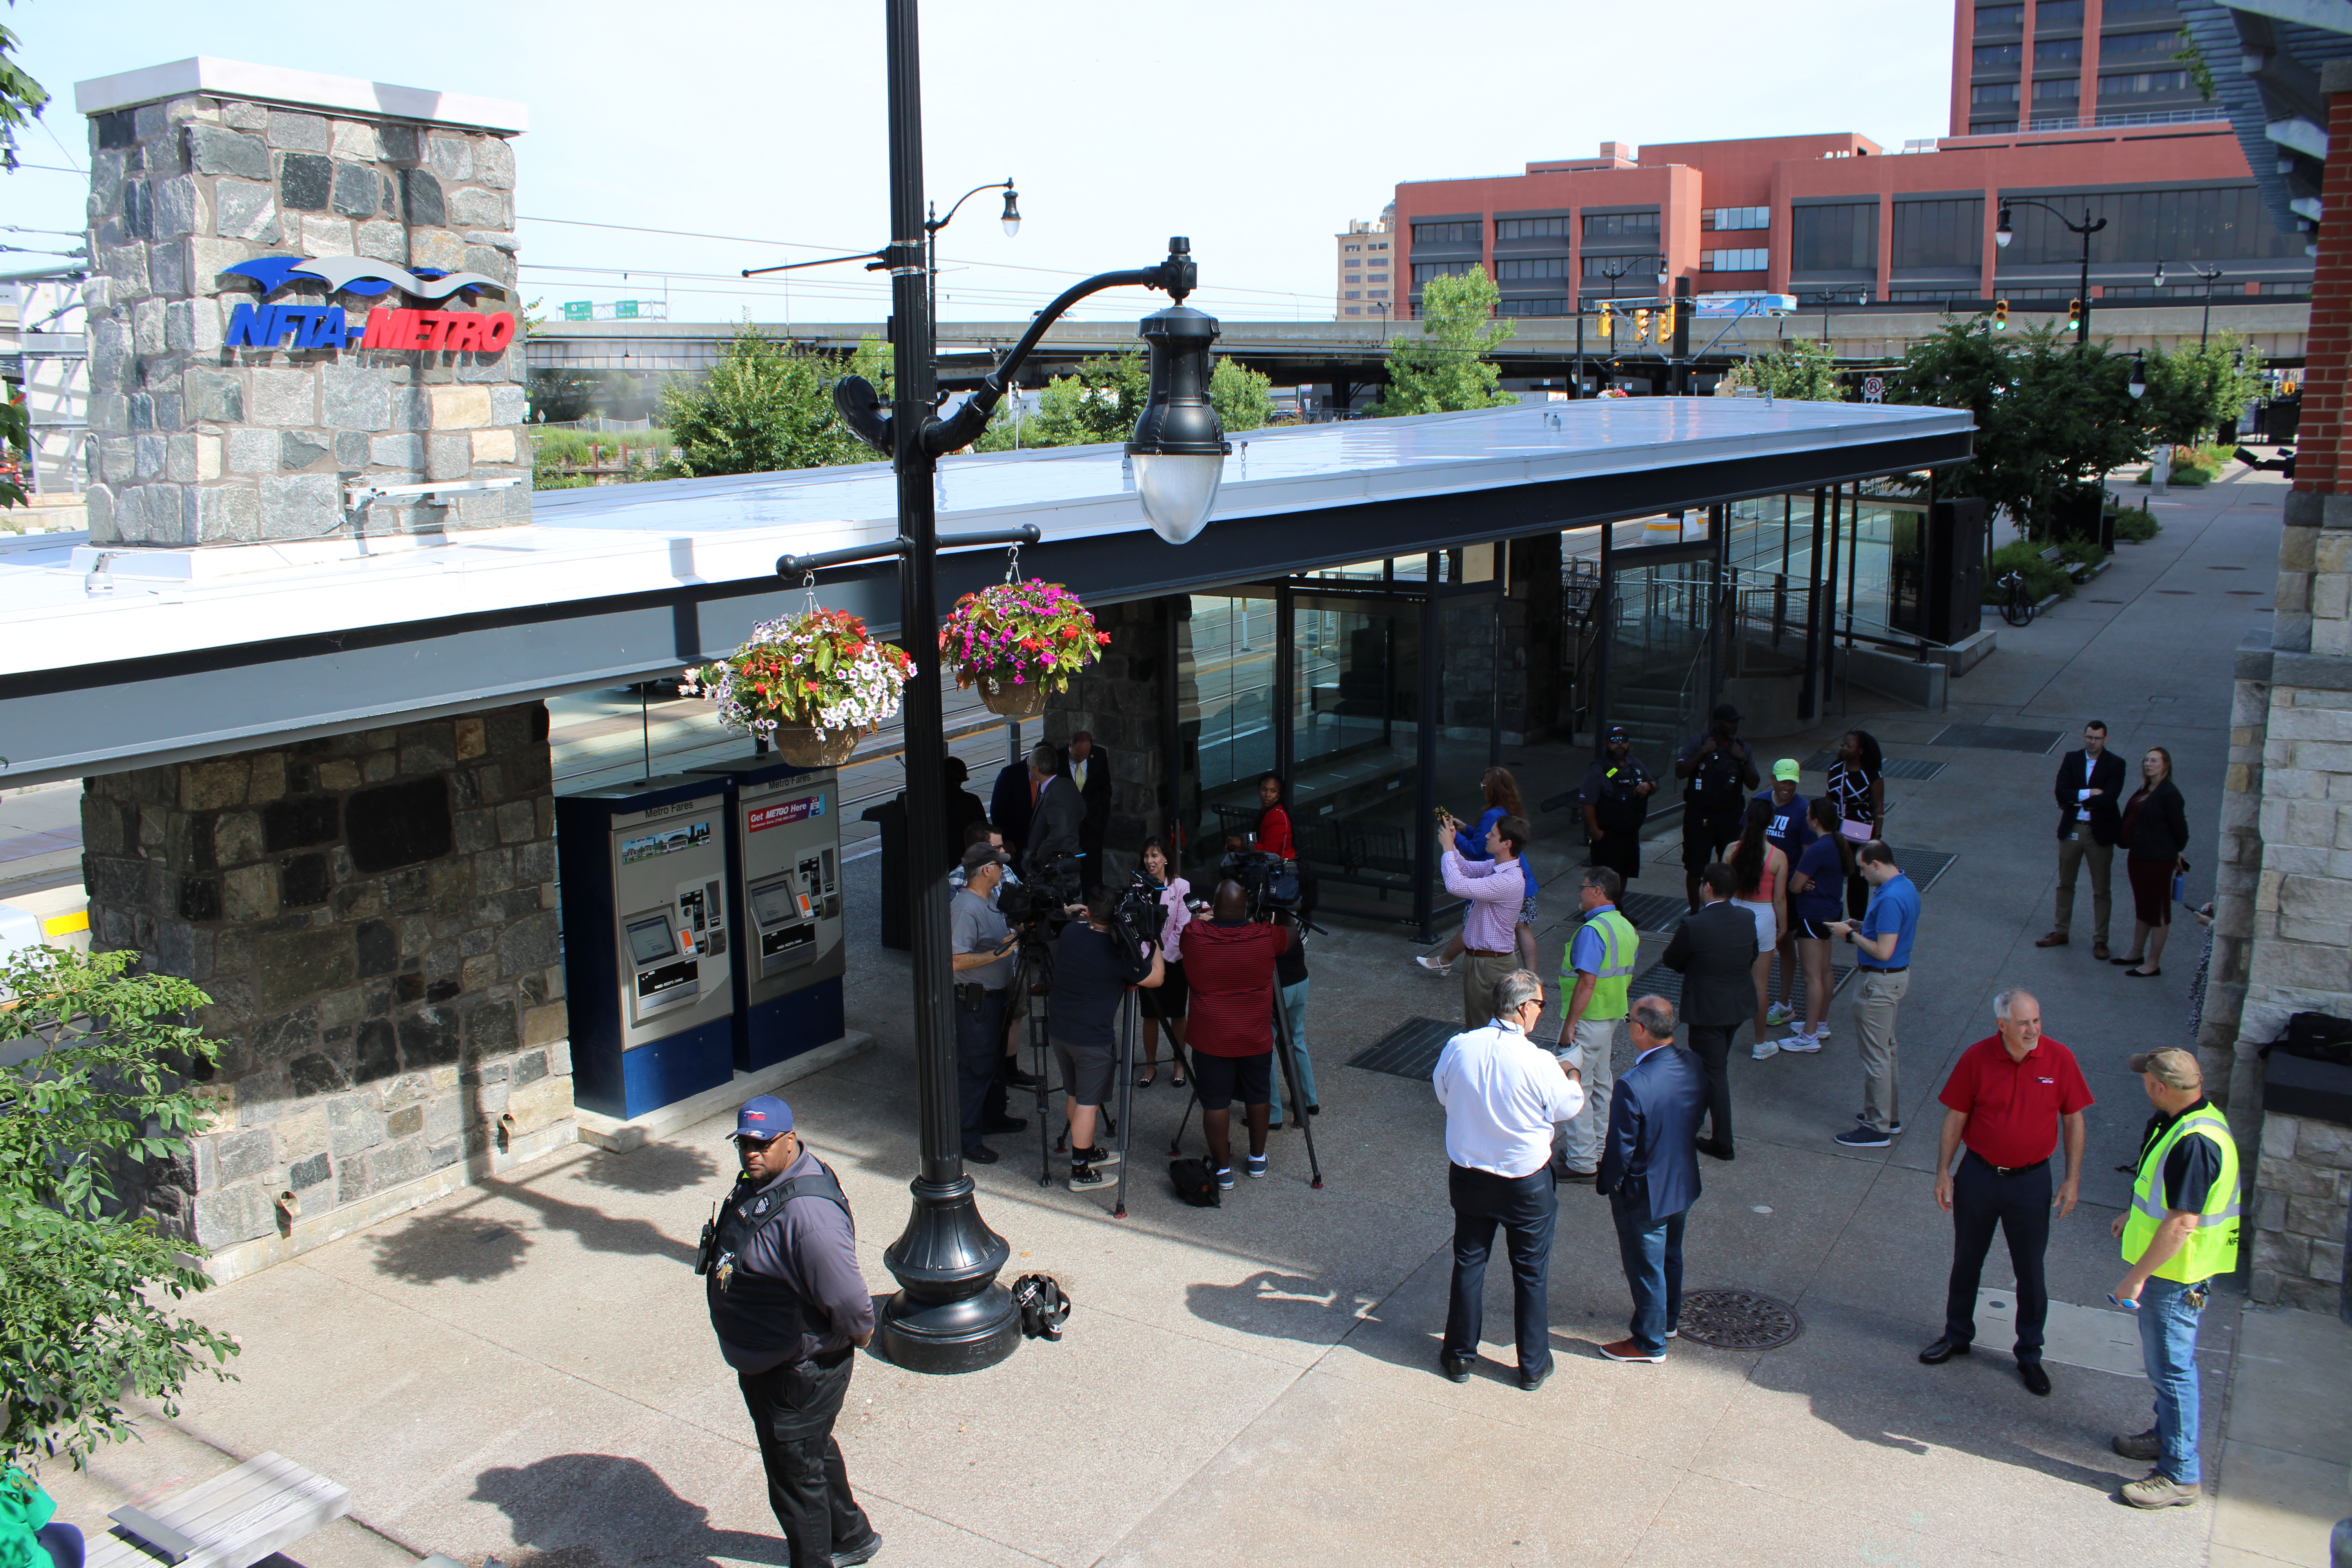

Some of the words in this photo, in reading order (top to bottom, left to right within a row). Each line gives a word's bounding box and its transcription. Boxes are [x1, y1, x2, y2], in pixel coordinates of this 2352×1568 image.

[223, 303, 515, 352] NFTA-METRO
[768, 778, 789, 790] Metro
[791, 774, 811, 784] Fares
[645, 806, 669, 818] Metro
[671, 801, 693, 813] Fares
[751, 813, 763, 822] Get
[765, 806, 789, 819] METGO
[791, 803, 807, 813] Here
